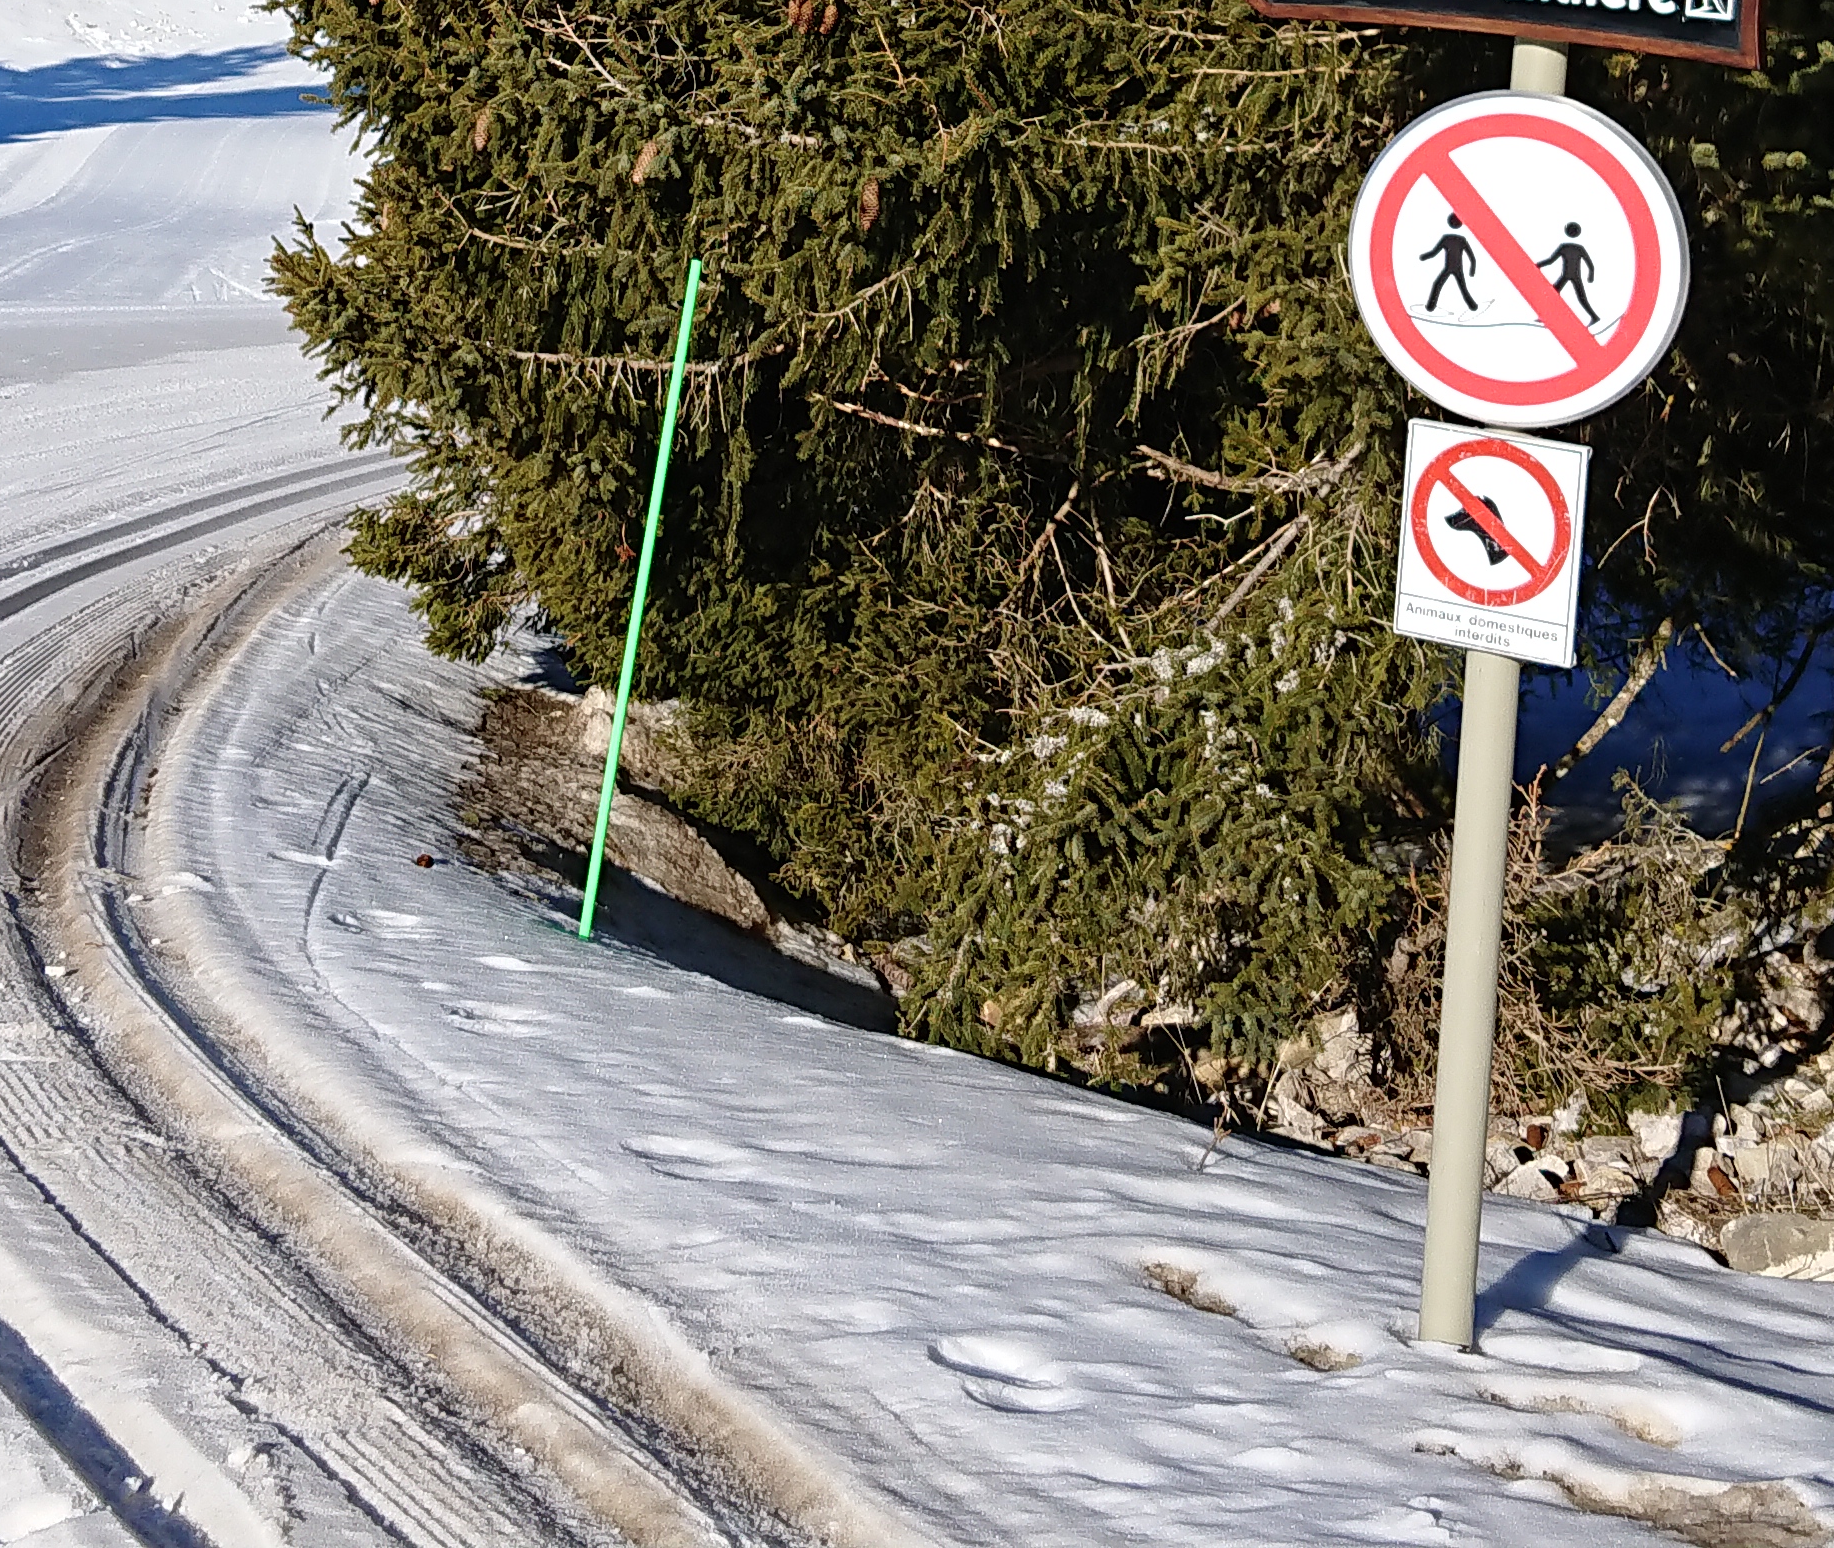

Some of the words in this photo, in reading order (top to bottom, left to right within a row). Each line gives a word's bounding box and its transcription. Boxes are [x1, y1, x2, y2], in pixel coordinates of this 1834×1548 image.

[1406, 602, 1462, 623] Animaux
[1468, 614, 1558, 642] domestiques
[1455, 626, 1511, 648] interdits
